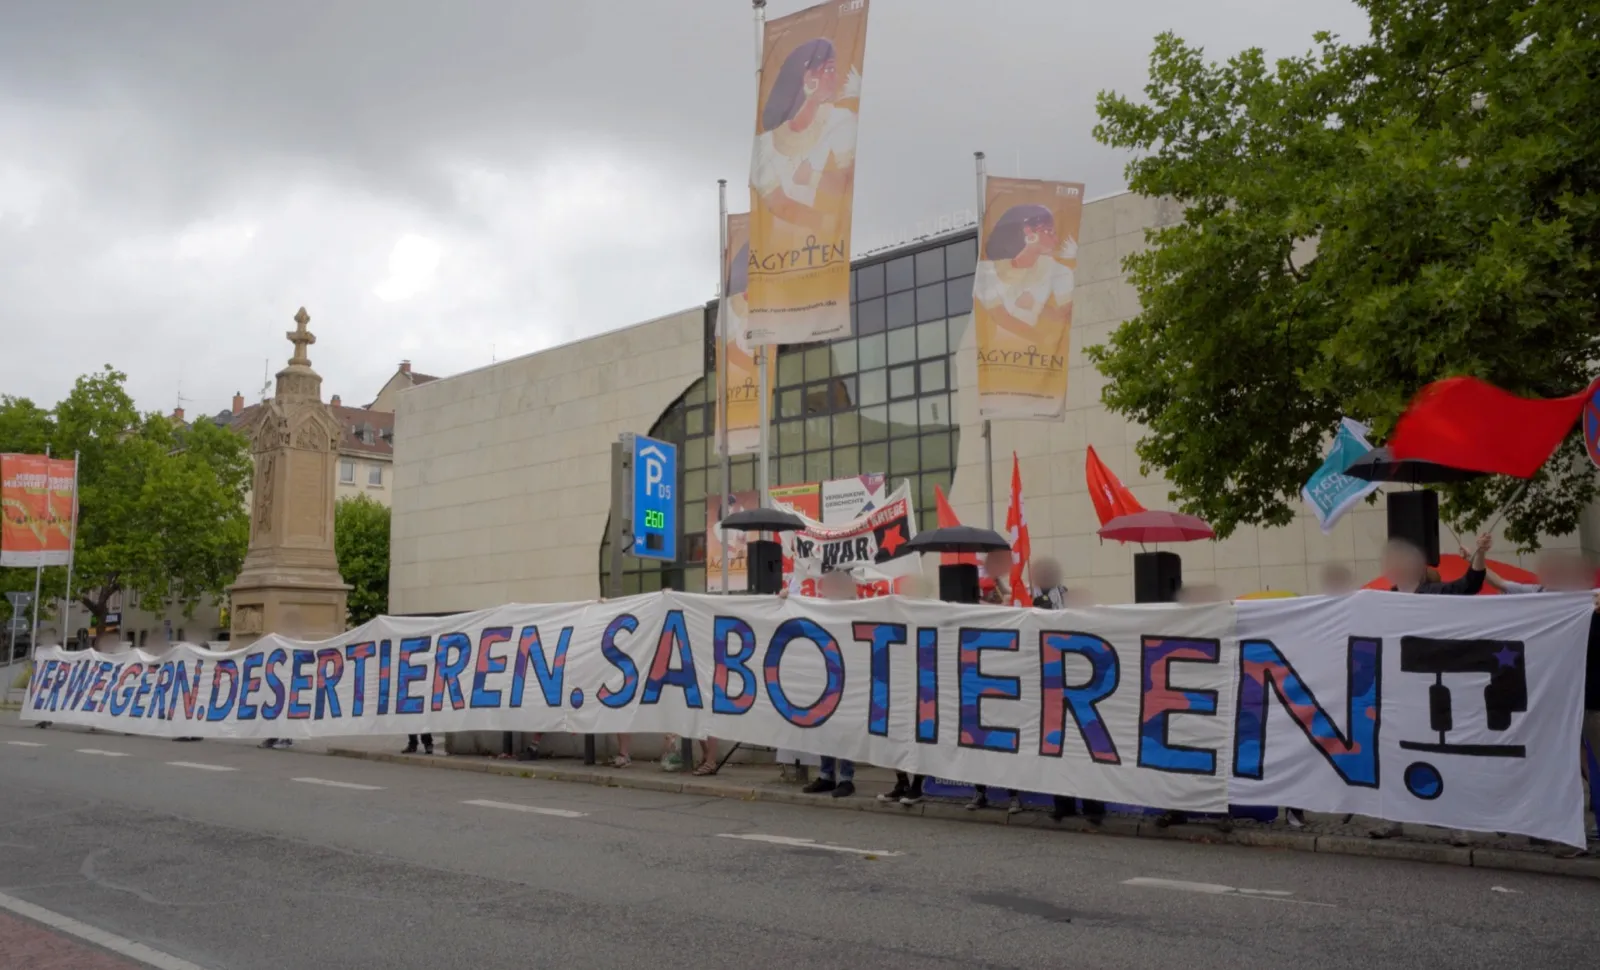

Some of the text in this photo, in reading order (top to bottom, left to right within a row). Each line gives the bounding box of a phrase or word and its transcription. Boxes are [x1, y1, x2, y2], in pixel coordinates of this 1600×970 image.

[646, 458, 663, 496] P
[645, 509, 664, 529] 260
[822, 537, 869, 565] WAR
